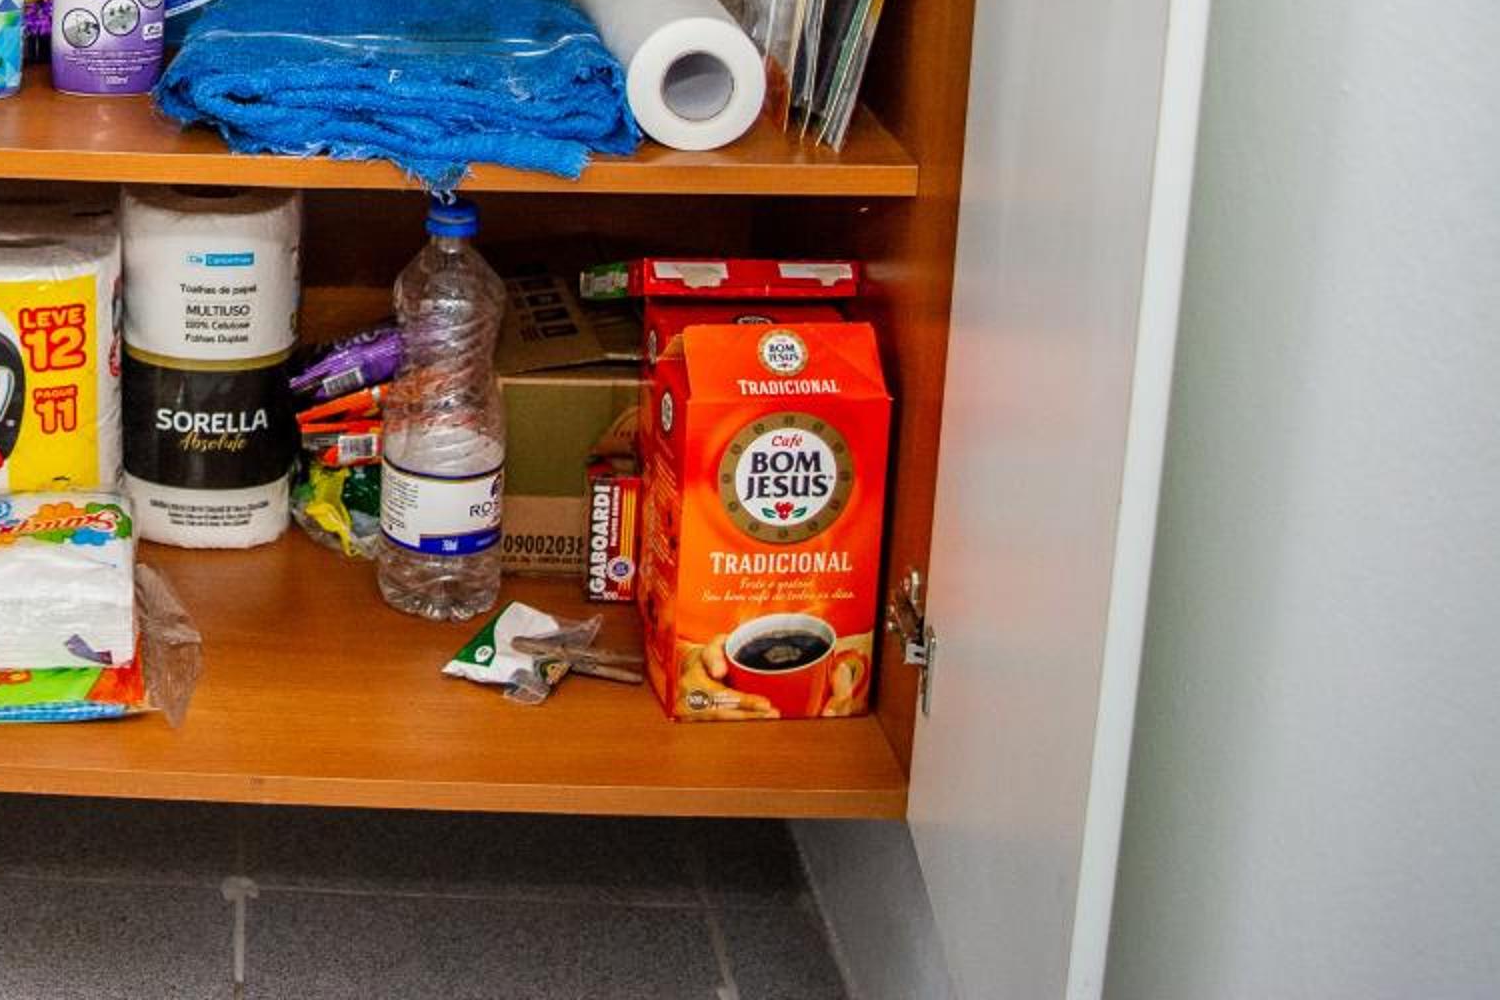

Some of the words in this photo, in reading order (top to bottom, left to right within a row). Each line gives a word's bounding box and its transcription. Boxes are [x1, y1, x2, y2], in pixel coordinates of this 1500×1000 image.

[19, 305, 86, 330] LEVE
[186, 304, 251, 317] MULTIUSO
[20, 326, 87, 374] 12
[768, 352, 799, 362] JESUS
[769, 343, 795, 352] BOM
[33, 385, 78, 401] PAQUE
[737, 379, 841, 395] TRADICIONAL
[34, 395, 77, 434] 11
[156, 408, 269, 434] SORELLA
[771, 434, 804, 448] Café
[750, 451, 821, 474] BOM
[744, 475, 829, 501] JESUS
[589, 485, 612, 593] GABOARDI
[709, 551, 853, 575] TRADICIONAL
